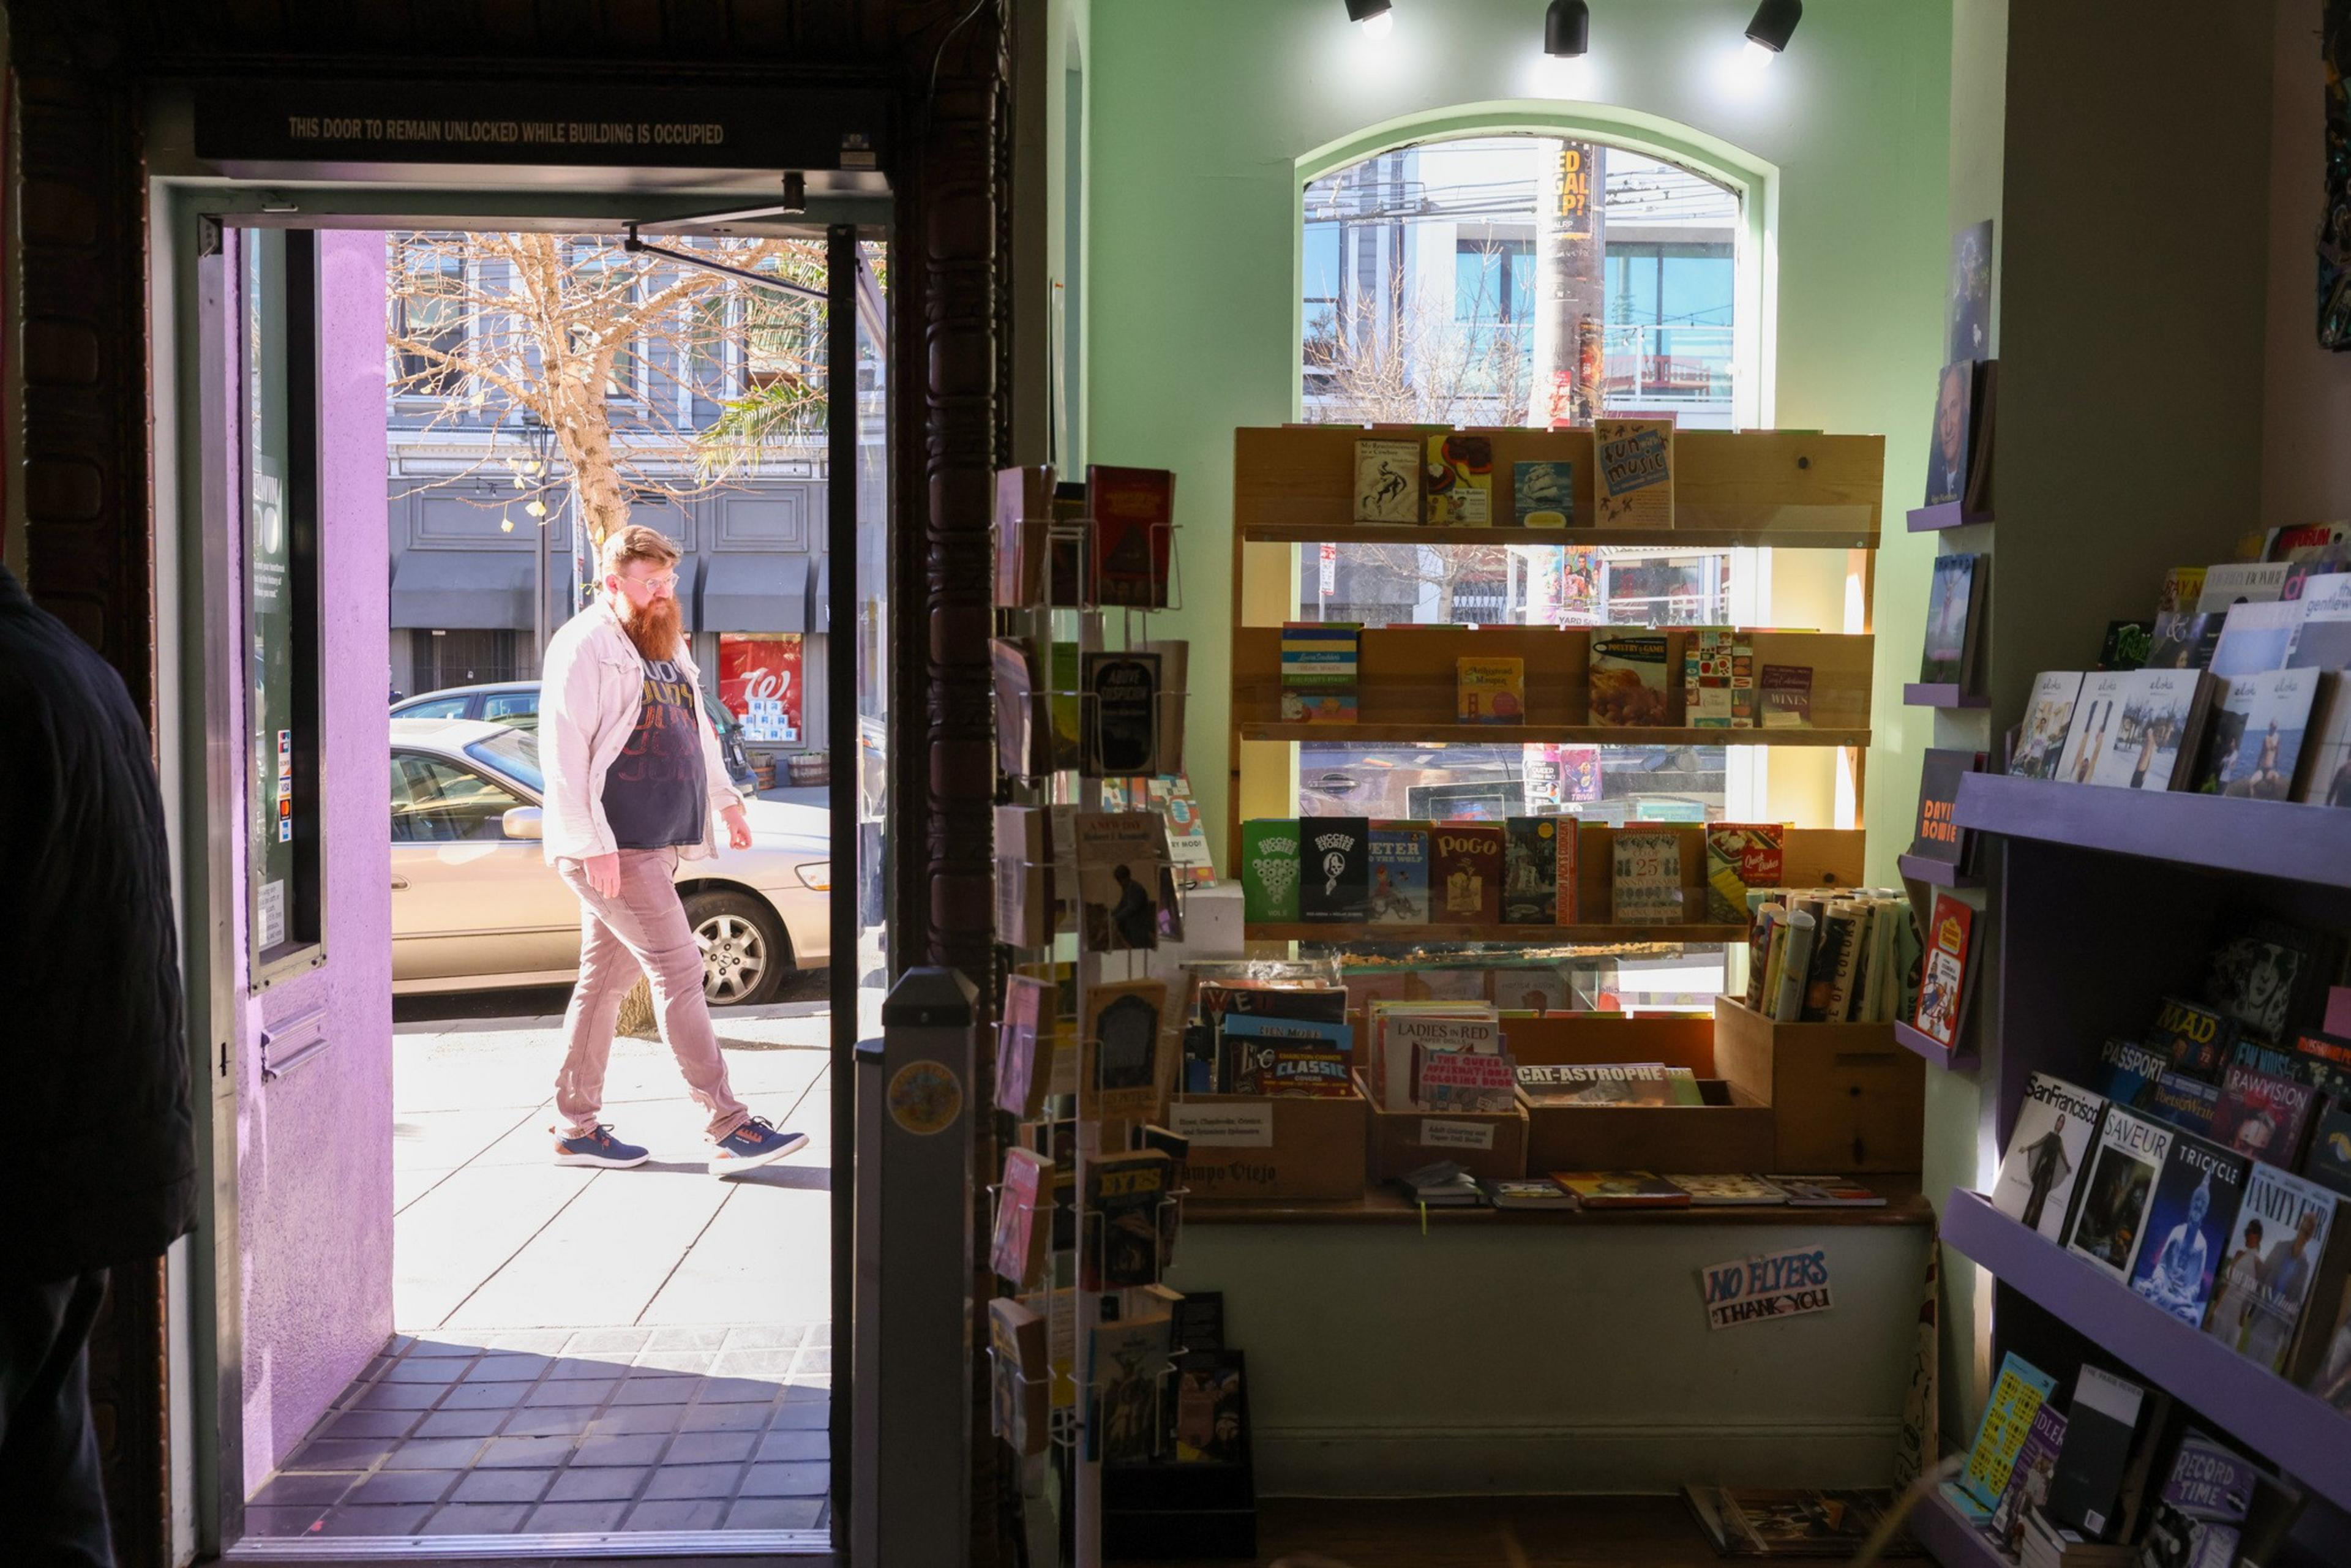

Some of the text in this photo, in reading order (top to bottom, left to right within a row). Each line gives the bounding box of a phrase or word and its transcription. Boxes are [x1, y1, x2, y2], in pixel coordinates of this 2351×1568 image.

[290, 117, 724, 144] THIS DOOR TO REMAIN UNLOCKED WHILE BUILDING IS OCCUPIED
[1608, 643, 1637, 653] POULTRY
[1772, 694, 1808, 705] WINES
[1314, 833, 1355, 845] SUCCESS
[1921, 819, 1957, 843] BOWIE
[1258, 836, 1297, 849] SUCCESS
[1261, 842, 1295, 855] STORIES
[1318, 840, 1352, 852] STORIES
[1438, 836, 1497, 856] POGO
[1837, 920, 1856, 978] COLORS
[1832, 983, 1844, 1002] OF
[1398, 1024, 1447, 1037] LADIES
[1461, 1026, 1489, 1040] RED
[2155, 1007, 2216, 1043] MAD
[1277, 1060, 1347, 1078] CLASSIC
[1436, 1055, 1500, 1066] THE QUEER
[2101, 1040, 2167, 1083] PASSPORT
[1426, 1063, 1510, 1078] AFFIRMATIONS
[1517, 1066, 1664, 1082] CAT-ASTROPHE
[1422, 1074, 1477, 1084] COLORING
[1482, 1077, 1514, 1087] BOOK
[2104, 1112, 2167, 1161] SAVEUR
[1185, 1165, 1224, 1185] ampo
[2178, 1145, 2240, 1186] TRICYCLE
[1708, 1250, 1829, 1304] NO FLYERS
[1714, 1288, 1831, 1325] THANK YOU
[2173, 1450, 2235, 1487] RECORD
[2179, 1479, 2220, 1506] TIME
